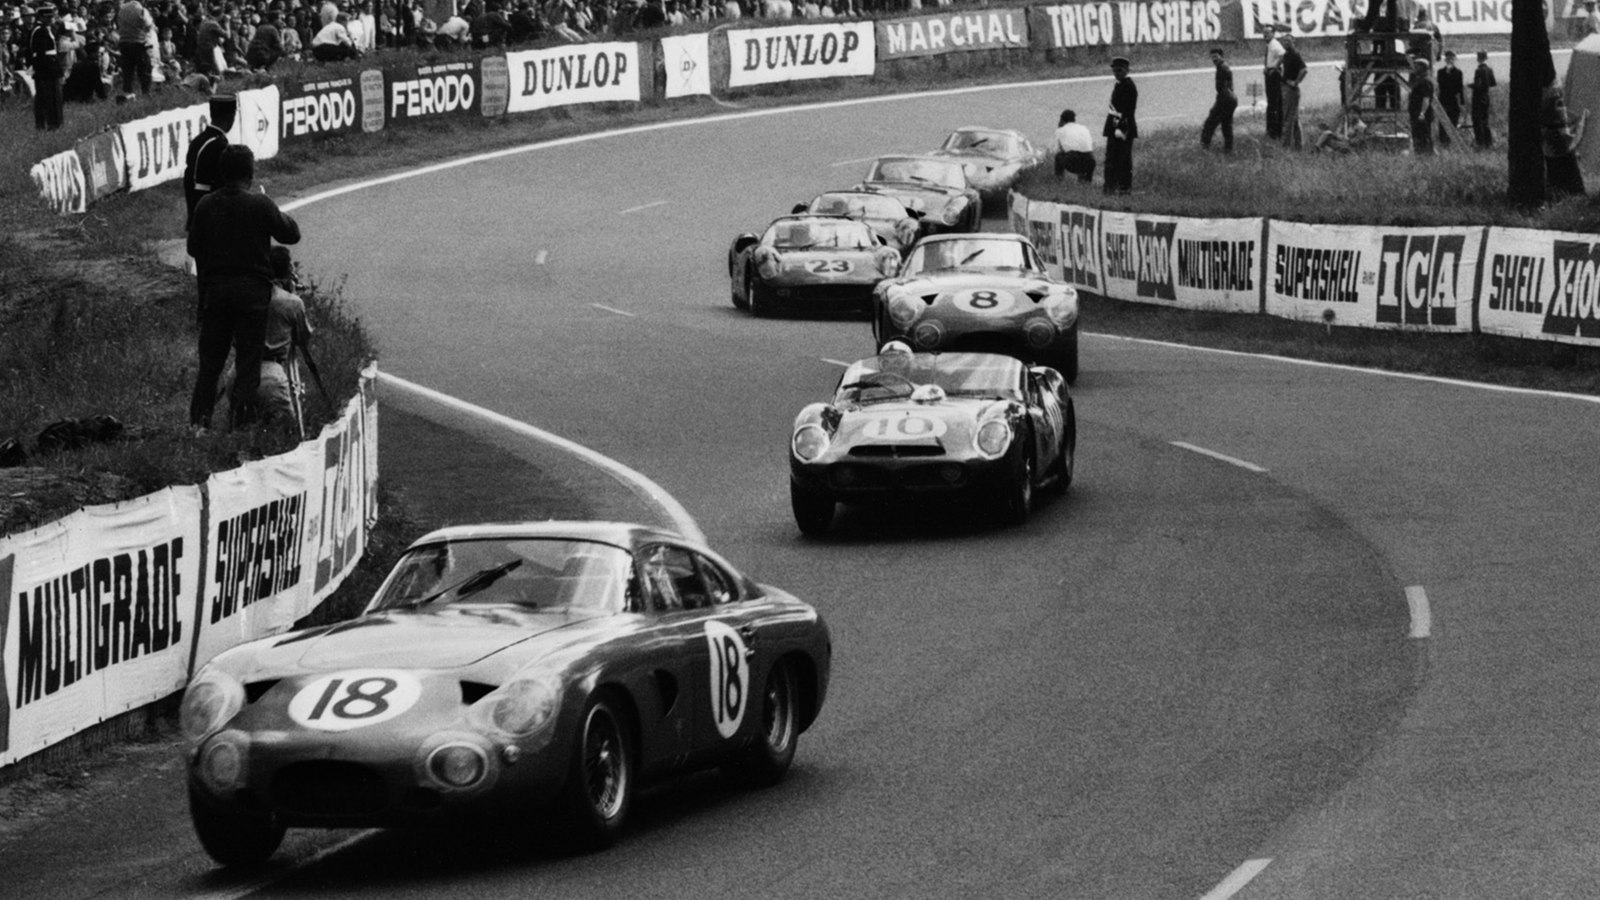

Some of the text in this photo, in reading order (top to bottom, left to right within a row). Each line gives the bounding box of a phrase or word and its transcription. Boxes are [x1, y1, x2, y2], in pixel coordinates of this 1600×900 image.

[887, 14, 1020, 54] MARCHAL
[1046, 0, 1221, 47] TRICO WASHERS
[522, 51, 628, 96] DUNLOP
[743, 31, 859, 71] DUNLOP
[282, 89, 356, 138] FERODO
[391, 73, 474, 118] FERODO
[812, 259, 850, 273] 23
[1106, 232, 1136, 281] SHELL
[1178, 239, 1254, 291] MULTIGRADE
[1275, 244, 1456, 309] SUPERSHELL ICA
[1489, 254, 1545, 314] SHELL
[969, 291, 999, 309] 8
[878, 416, 933, 435] 10
[16, 537, 183, 709] MULTIGRADE
[307, 677, 398, 720] 18
[713, 635, 742, 724] 18
